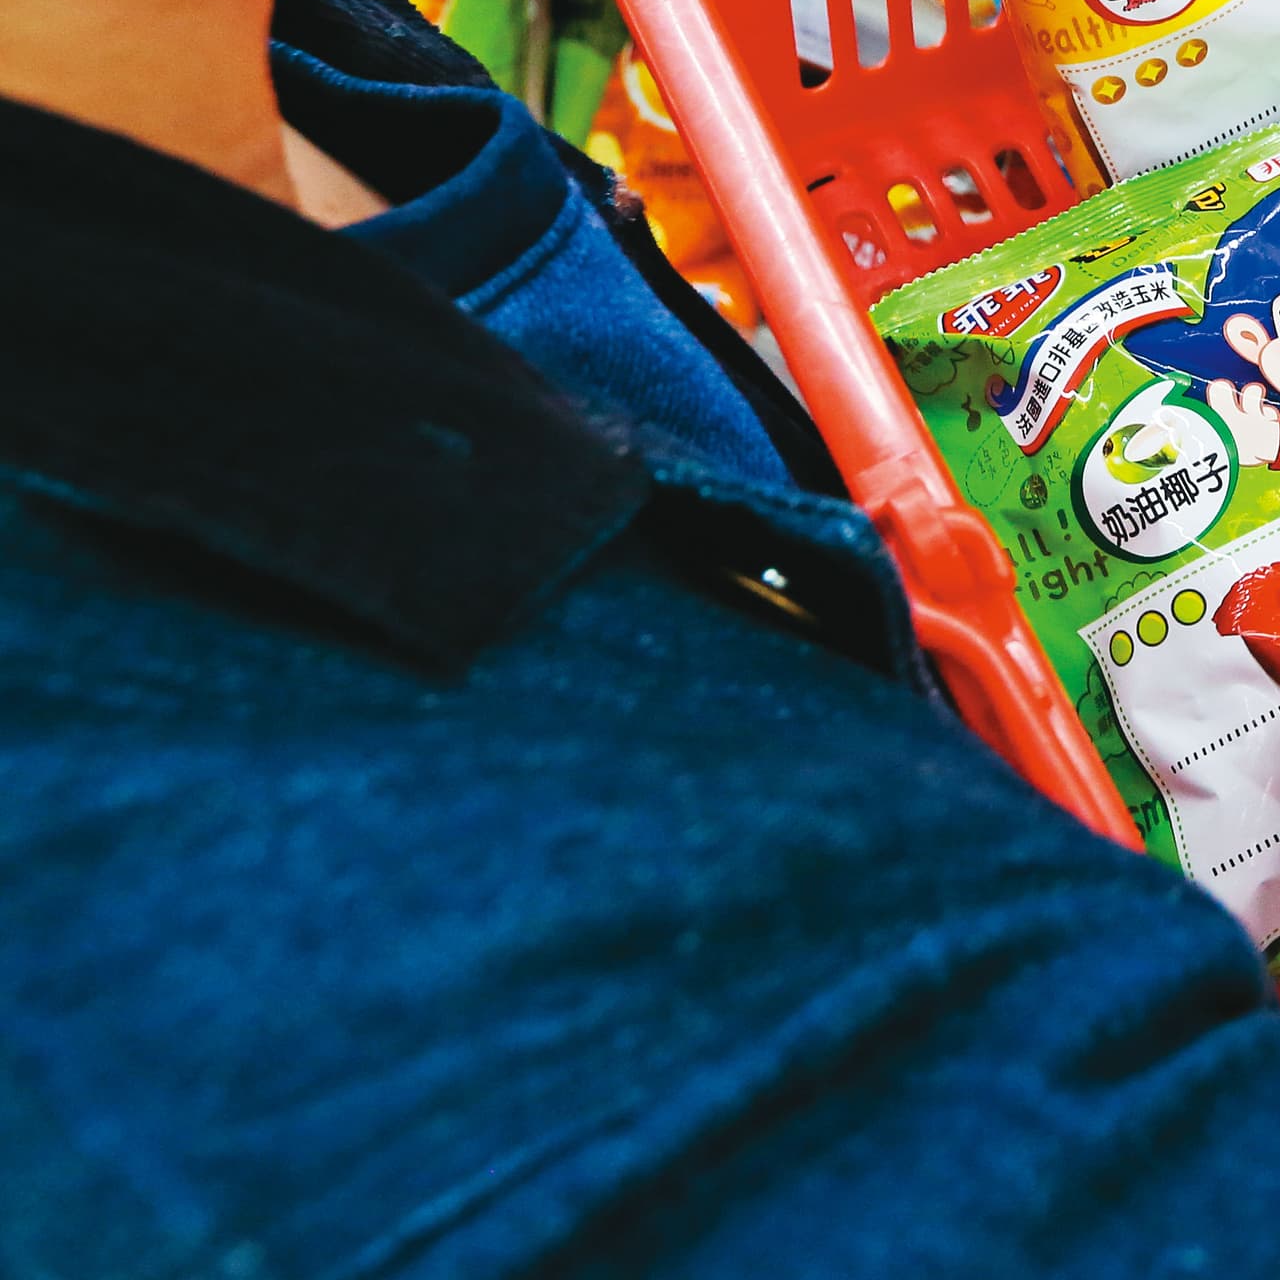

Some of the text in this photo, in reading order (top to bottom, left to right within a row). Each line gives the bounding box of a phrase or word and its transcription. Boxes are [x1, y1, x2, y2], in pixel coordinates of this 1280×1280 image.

[1022, 16, 1128, 56] ealth
[1101, 453, 1228, 547] 奶油椰子
